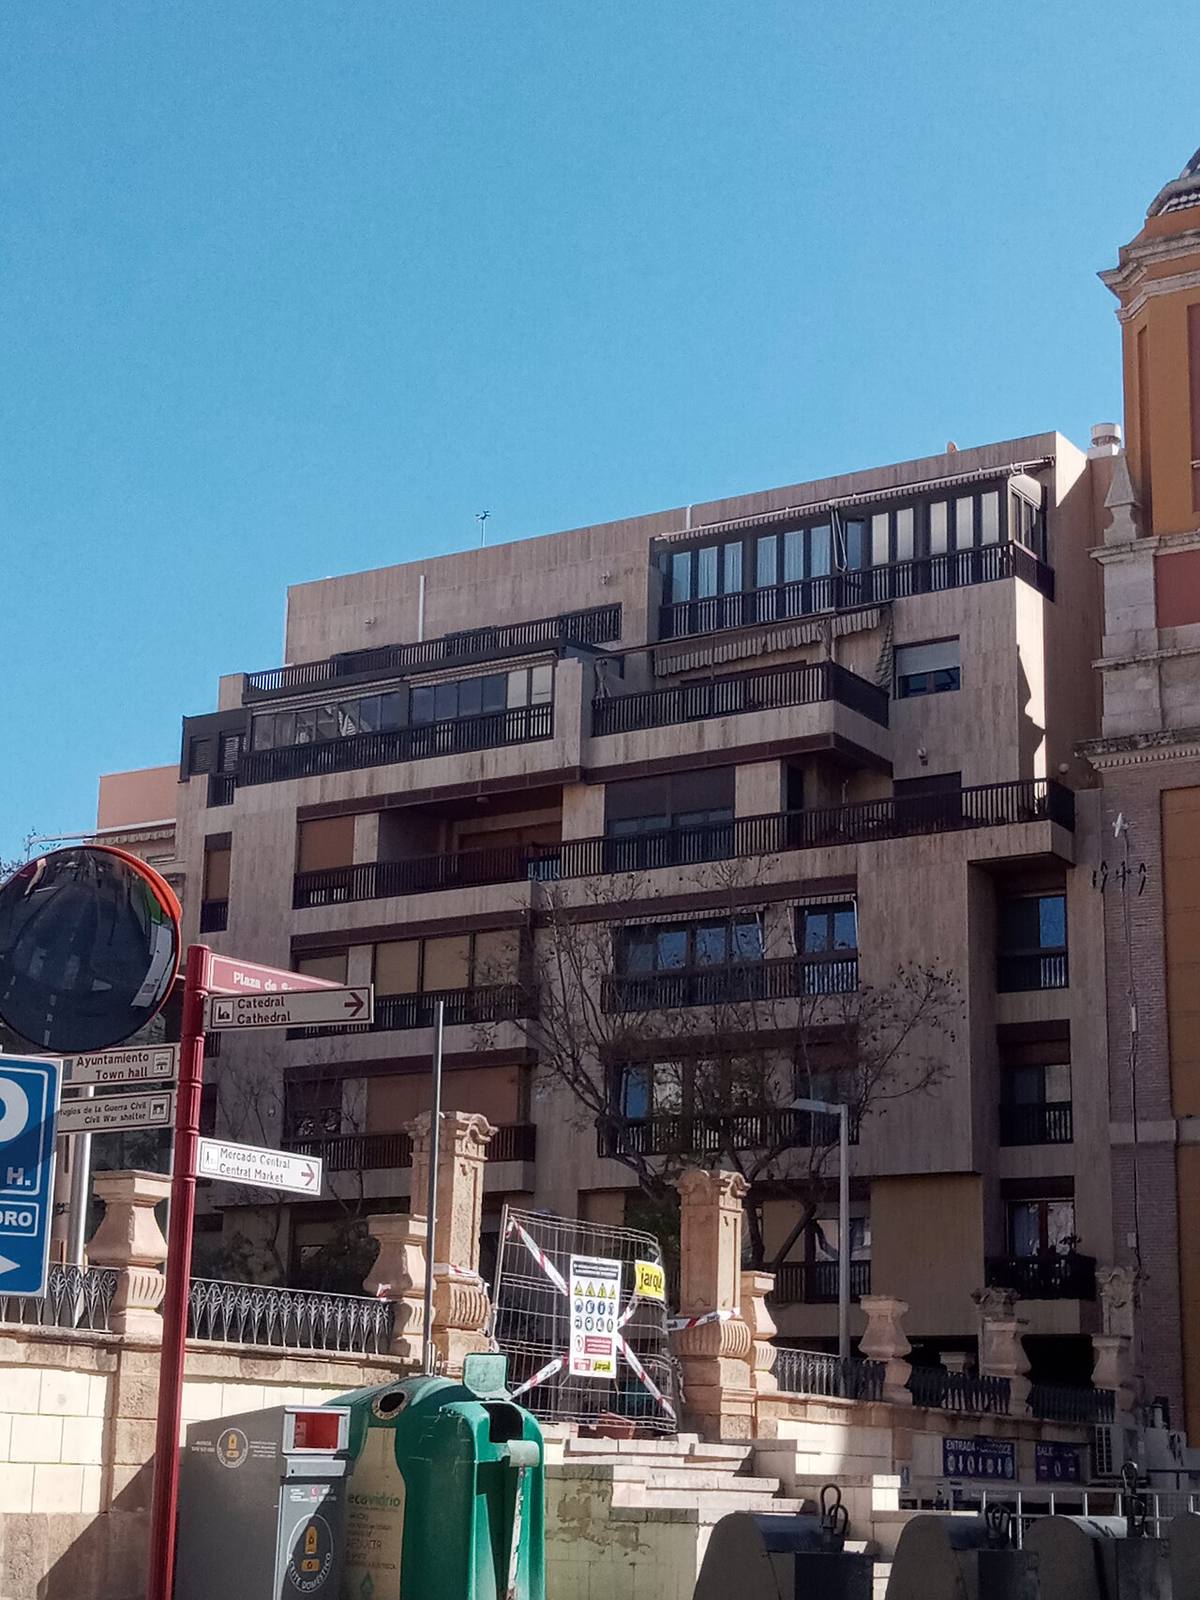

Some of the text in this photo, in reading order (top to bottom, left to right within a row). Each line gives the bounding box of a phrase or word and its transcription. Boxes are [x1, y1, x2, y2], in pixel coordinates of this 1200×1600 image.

[233, 971, 261, 989] Plaza
[237, 996, 285, 1009] Catedral
[237, 1011, 291, 1024] Cathedral
[77, 1052, 149, 1068] Ayuntamiento
[95, 1066, 148, 1081] Town hall
[83, 1106, 92, 1114] de
[95, 1105, 102, 1113] la
[104, 1104, 128, 1112] Guerra
[130, 1102, 147, 1110] Civil
[85, 1112, 146, 1124] Civil War shelter
[220, 1147, 290, 1169] Mercado Central
[219, 1162, 284, 1184] Central Market
[0, 1210, 33, 1228] RO
